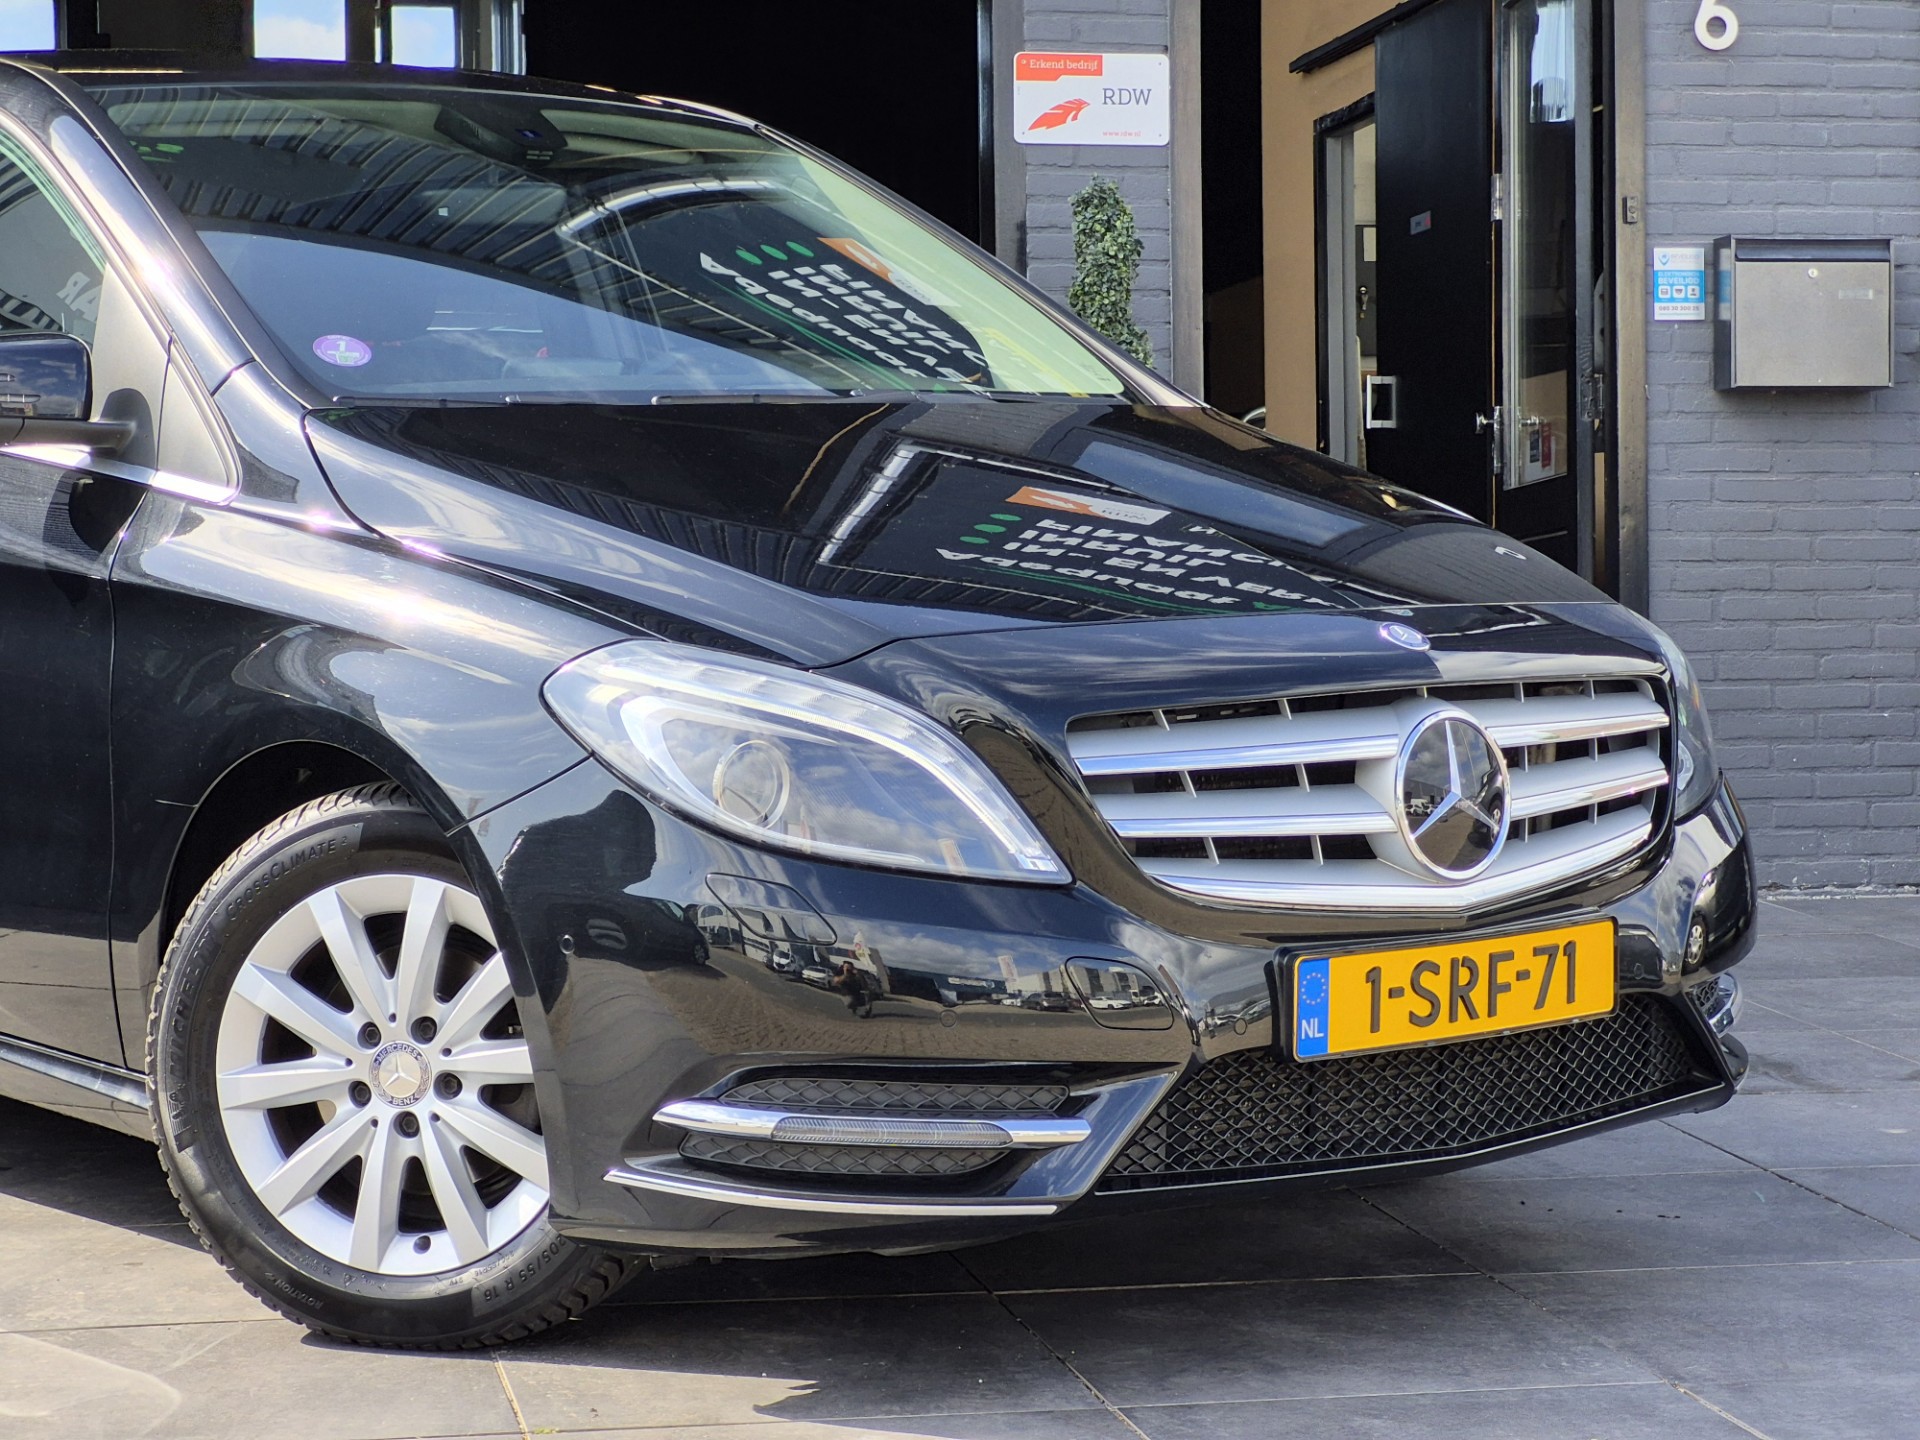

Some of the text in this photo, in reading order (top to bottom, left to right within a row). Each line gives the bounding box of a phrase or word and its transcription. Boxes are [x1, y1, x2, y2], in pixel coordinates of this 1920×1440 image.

[1694, 0, 1738, 50] 6
[1029, 59, 1098, 71] Erkend bedrijf
[1102, 88, 1152, 106] RDW
[226, 838, 337, 921] CROSSCLIMATE
[1365, 940, 1577, 1034] 1-SRF-71
[1301, 1017, 1325, 1040] NL
[376, 1043, 419, 1062] MERCEDES
[393, 1095, 416, 1106] BENZ
[484, 1235, 566, 1301] 205/55 R 16
